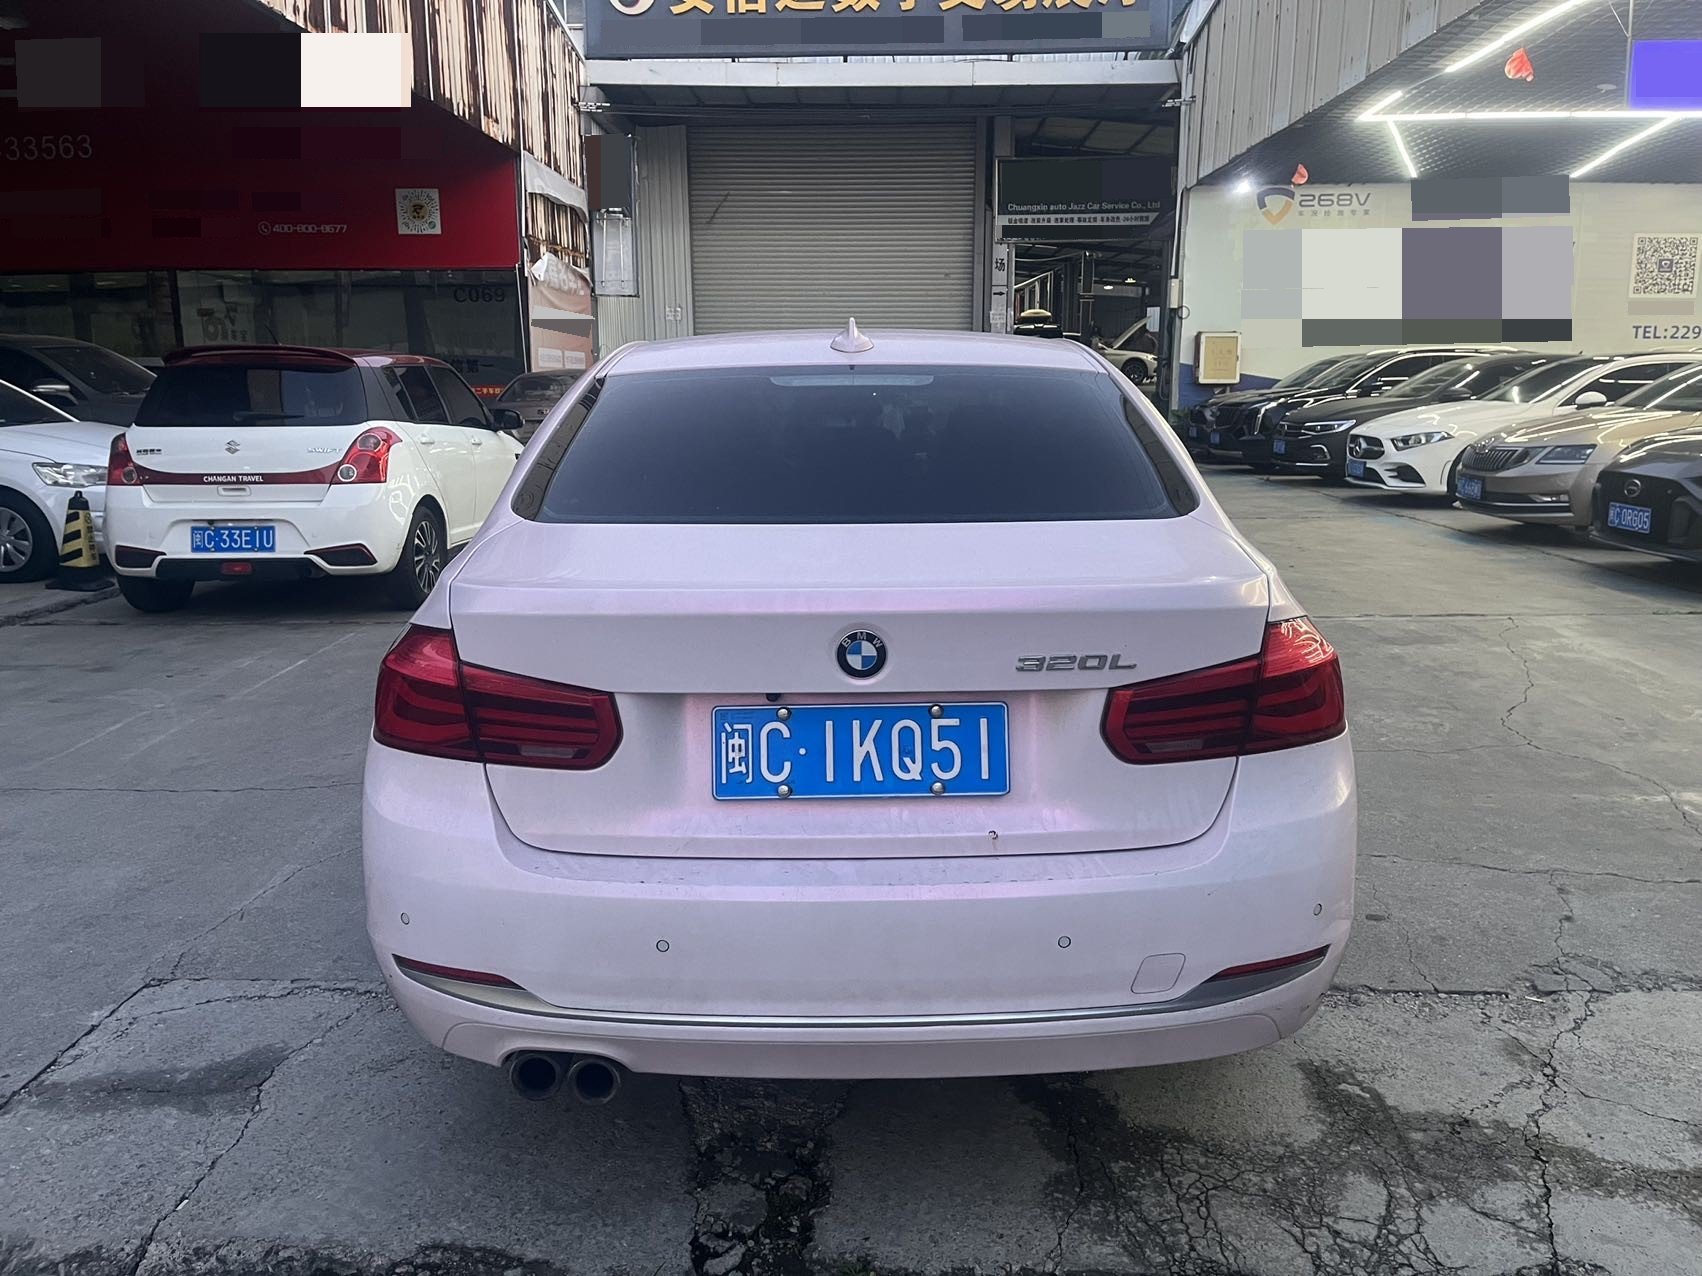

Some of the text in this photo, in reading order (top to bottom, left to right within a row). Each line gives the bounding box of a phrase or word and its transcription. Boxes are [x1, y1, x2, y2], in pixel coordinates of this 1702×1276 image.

[1008, 203, 1048, 212] Chuangxin
[1087, 202, 1100, 210] Car
[1102, 202, 1130, 210] Service
[1298, 192, 1371, 208] 268V
[453, 287, 505, 302] C069
[203, 475, 237, 483] CHANGAN
[1016, 654, 1137, 672] 320L
